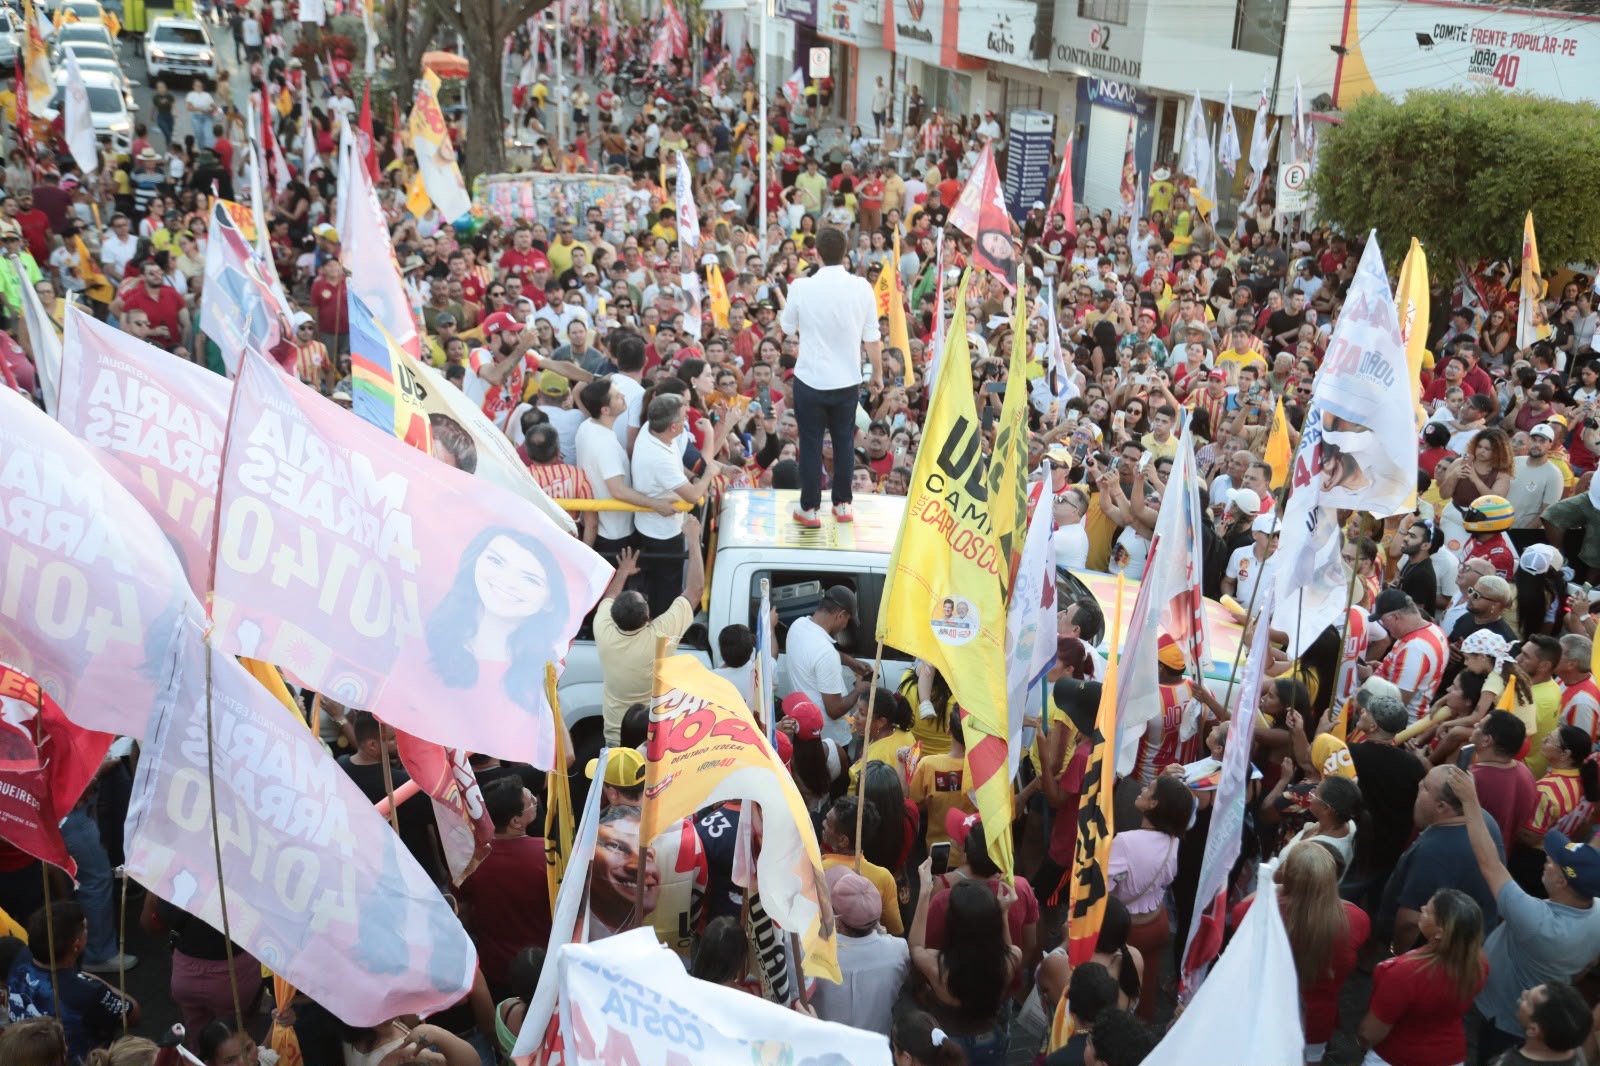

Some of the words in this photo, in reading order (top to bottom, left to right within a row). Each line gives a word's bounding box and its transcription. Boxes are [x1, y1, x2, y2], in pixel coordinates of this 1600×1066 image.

[1470, 27, 1508, 48] FRENTE
[1510, 32, 1578, 56] POPULAR-PE
[1470, 48, 1498, 67] JOÃO
[1493, 54, 1521, 88] 40
[1291, 170, 1299, 184] E
[926, 473, 994, 536] CAM
[670, 747, 710, 765] DEPUTADO
[711, 744, 746, 752] FEDERAL
[701, 811, 733, 839] 33
